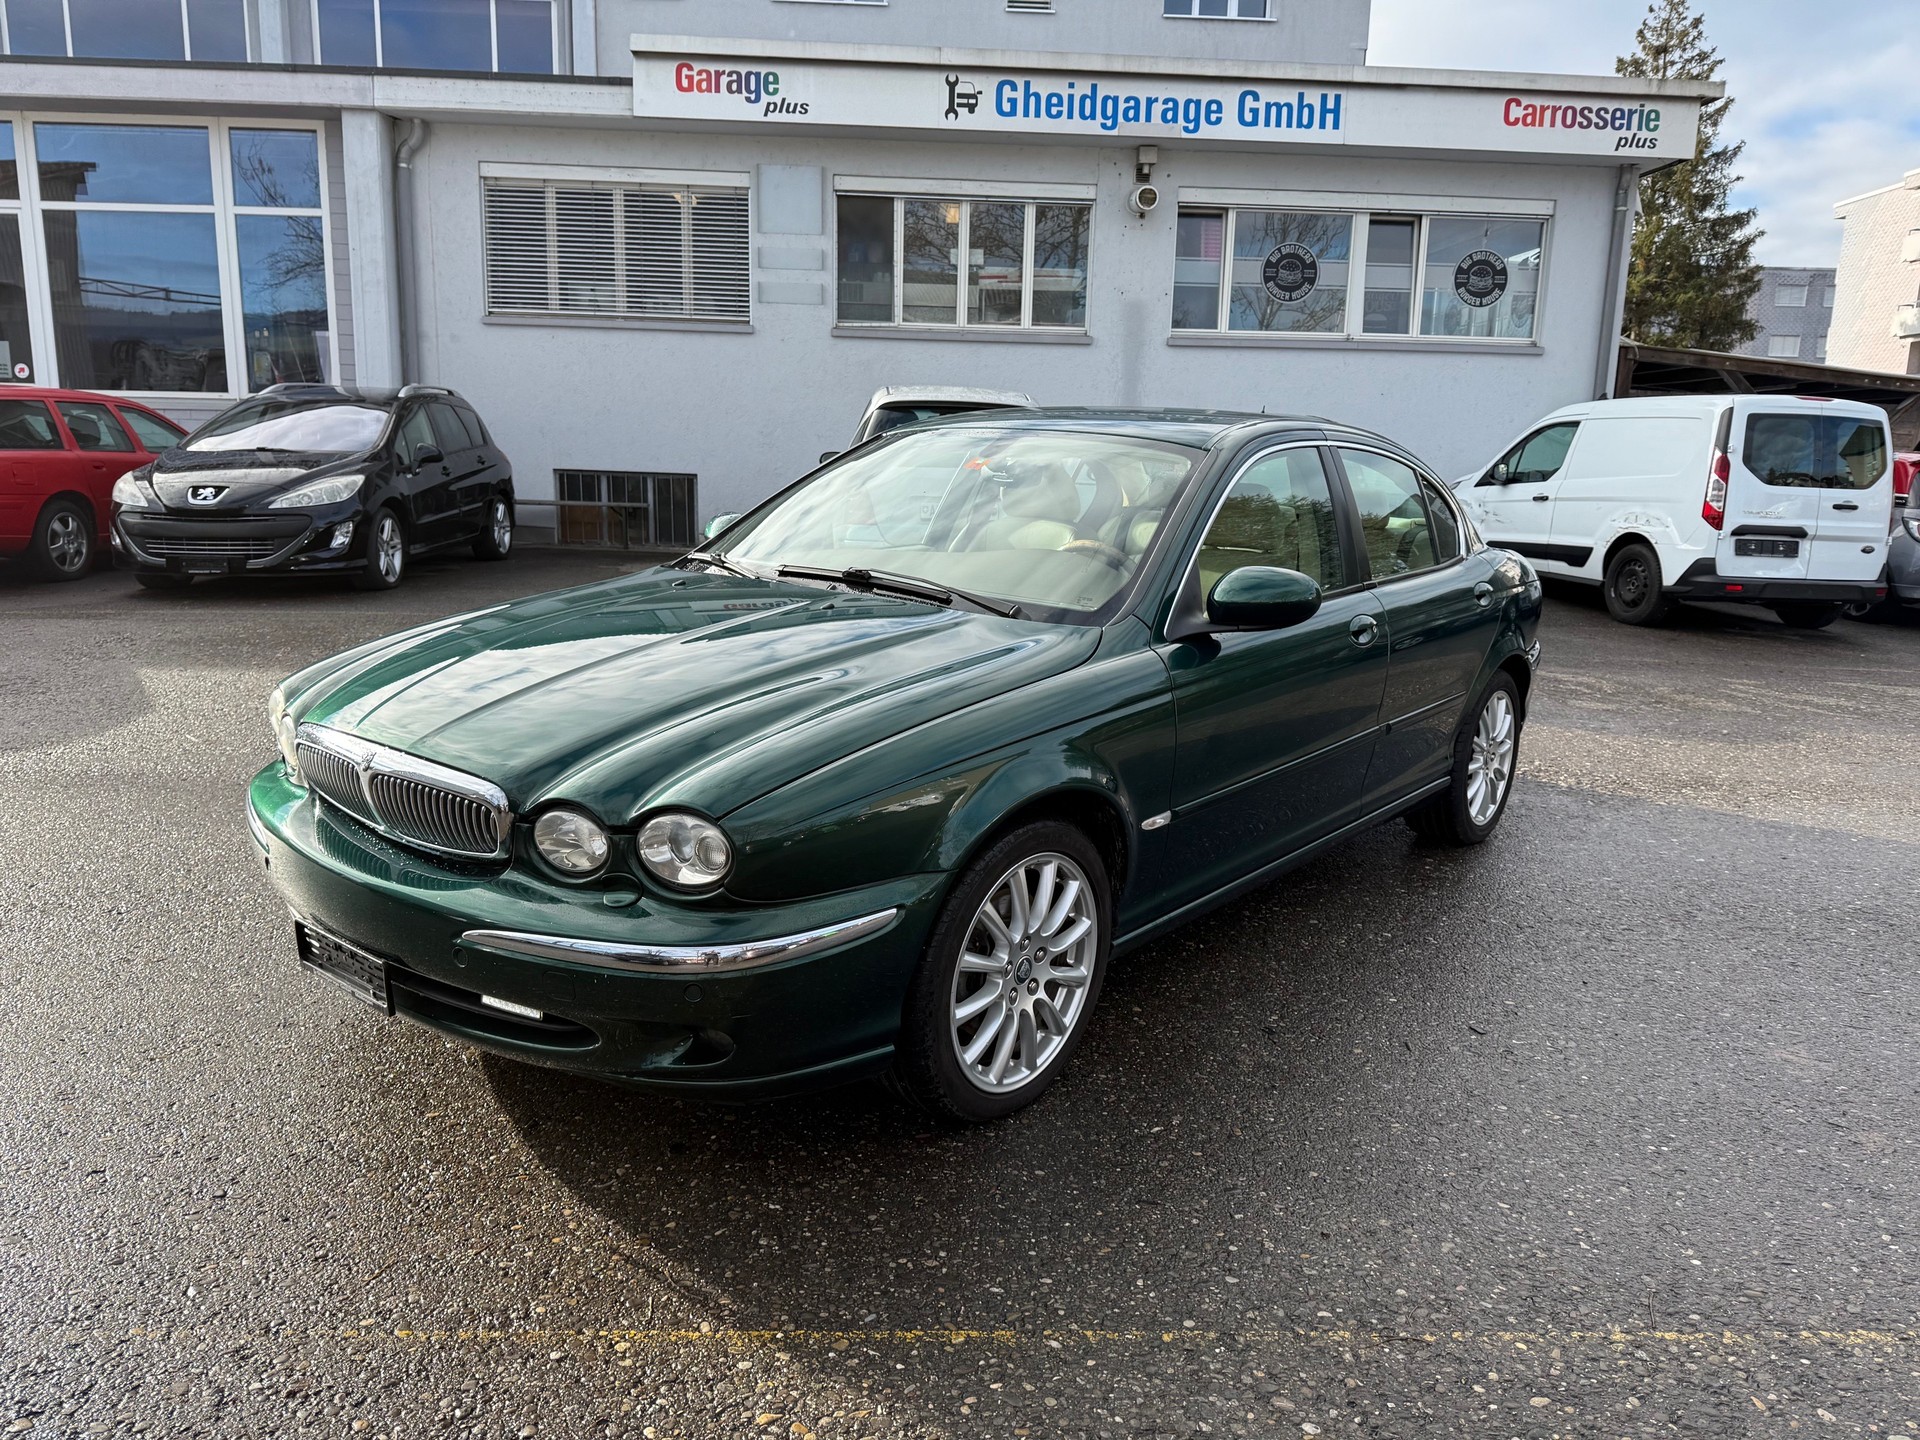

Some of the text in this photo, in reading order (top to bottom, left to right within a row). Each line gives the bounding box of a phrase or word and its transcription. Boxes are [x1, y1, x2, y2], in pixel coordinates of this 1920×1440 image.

[675, 61, 780, 104] Garage
[763, 97, 810, 117] plus
[994, 79, 1342, 134] Gheidgarage GmbH
[1503, 97, 1661, 132] Carrosserie
[1614, 133, 1659, 151] plus
[1269, 245, 1313, 263] BIG BROTHERS
[1461, 252, 1504, 270] BIG BROTHERS
[1267, 281, 1312, 300] BURGER HOUSE
[1458, 287, 1502, 305] BURGER HOUSE
